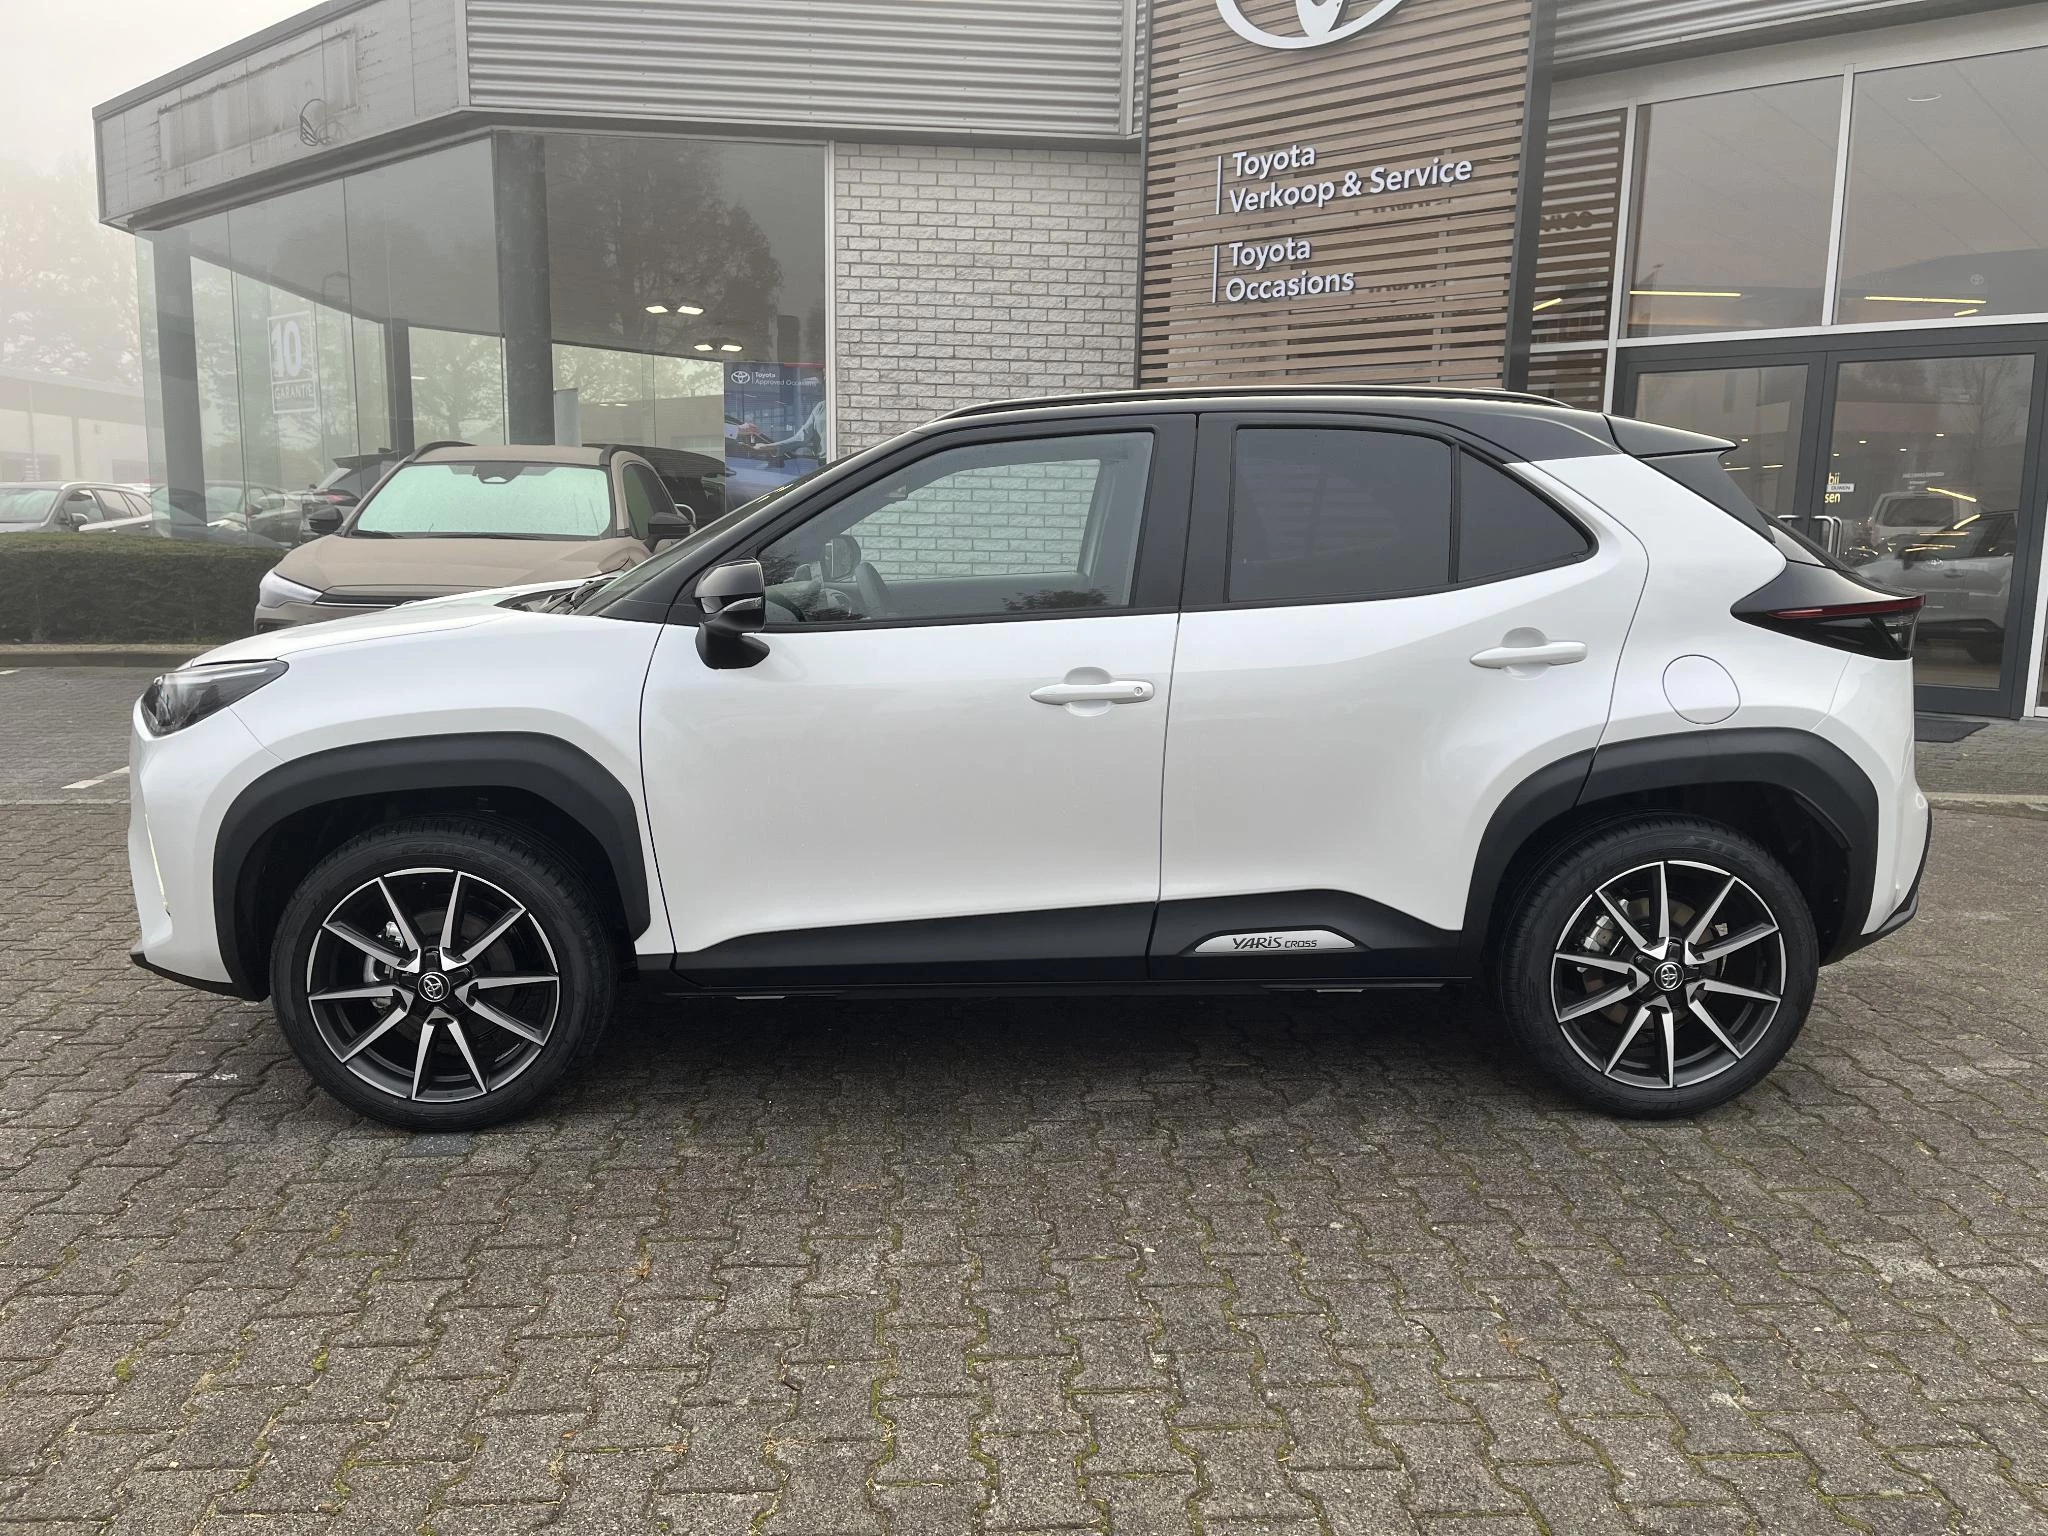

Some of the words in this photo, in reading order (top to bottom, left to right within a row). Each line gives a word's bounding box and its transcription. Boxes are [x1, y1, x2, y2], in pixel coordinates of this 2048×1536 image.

[1232, 144, 1316, 180] Toyota
[1229, 181, 1335, 213] Verkoop
[1341, 170, 1362, 198] &
[1370, 157, 1473, 194] Service
[1228, 237, 1312, 271] Toyota
[1225, 270, 1355, 302] Occasions
[274, 383, 313, 400] GARANTIE
[1284, 940, 1317, 948] CROSS
